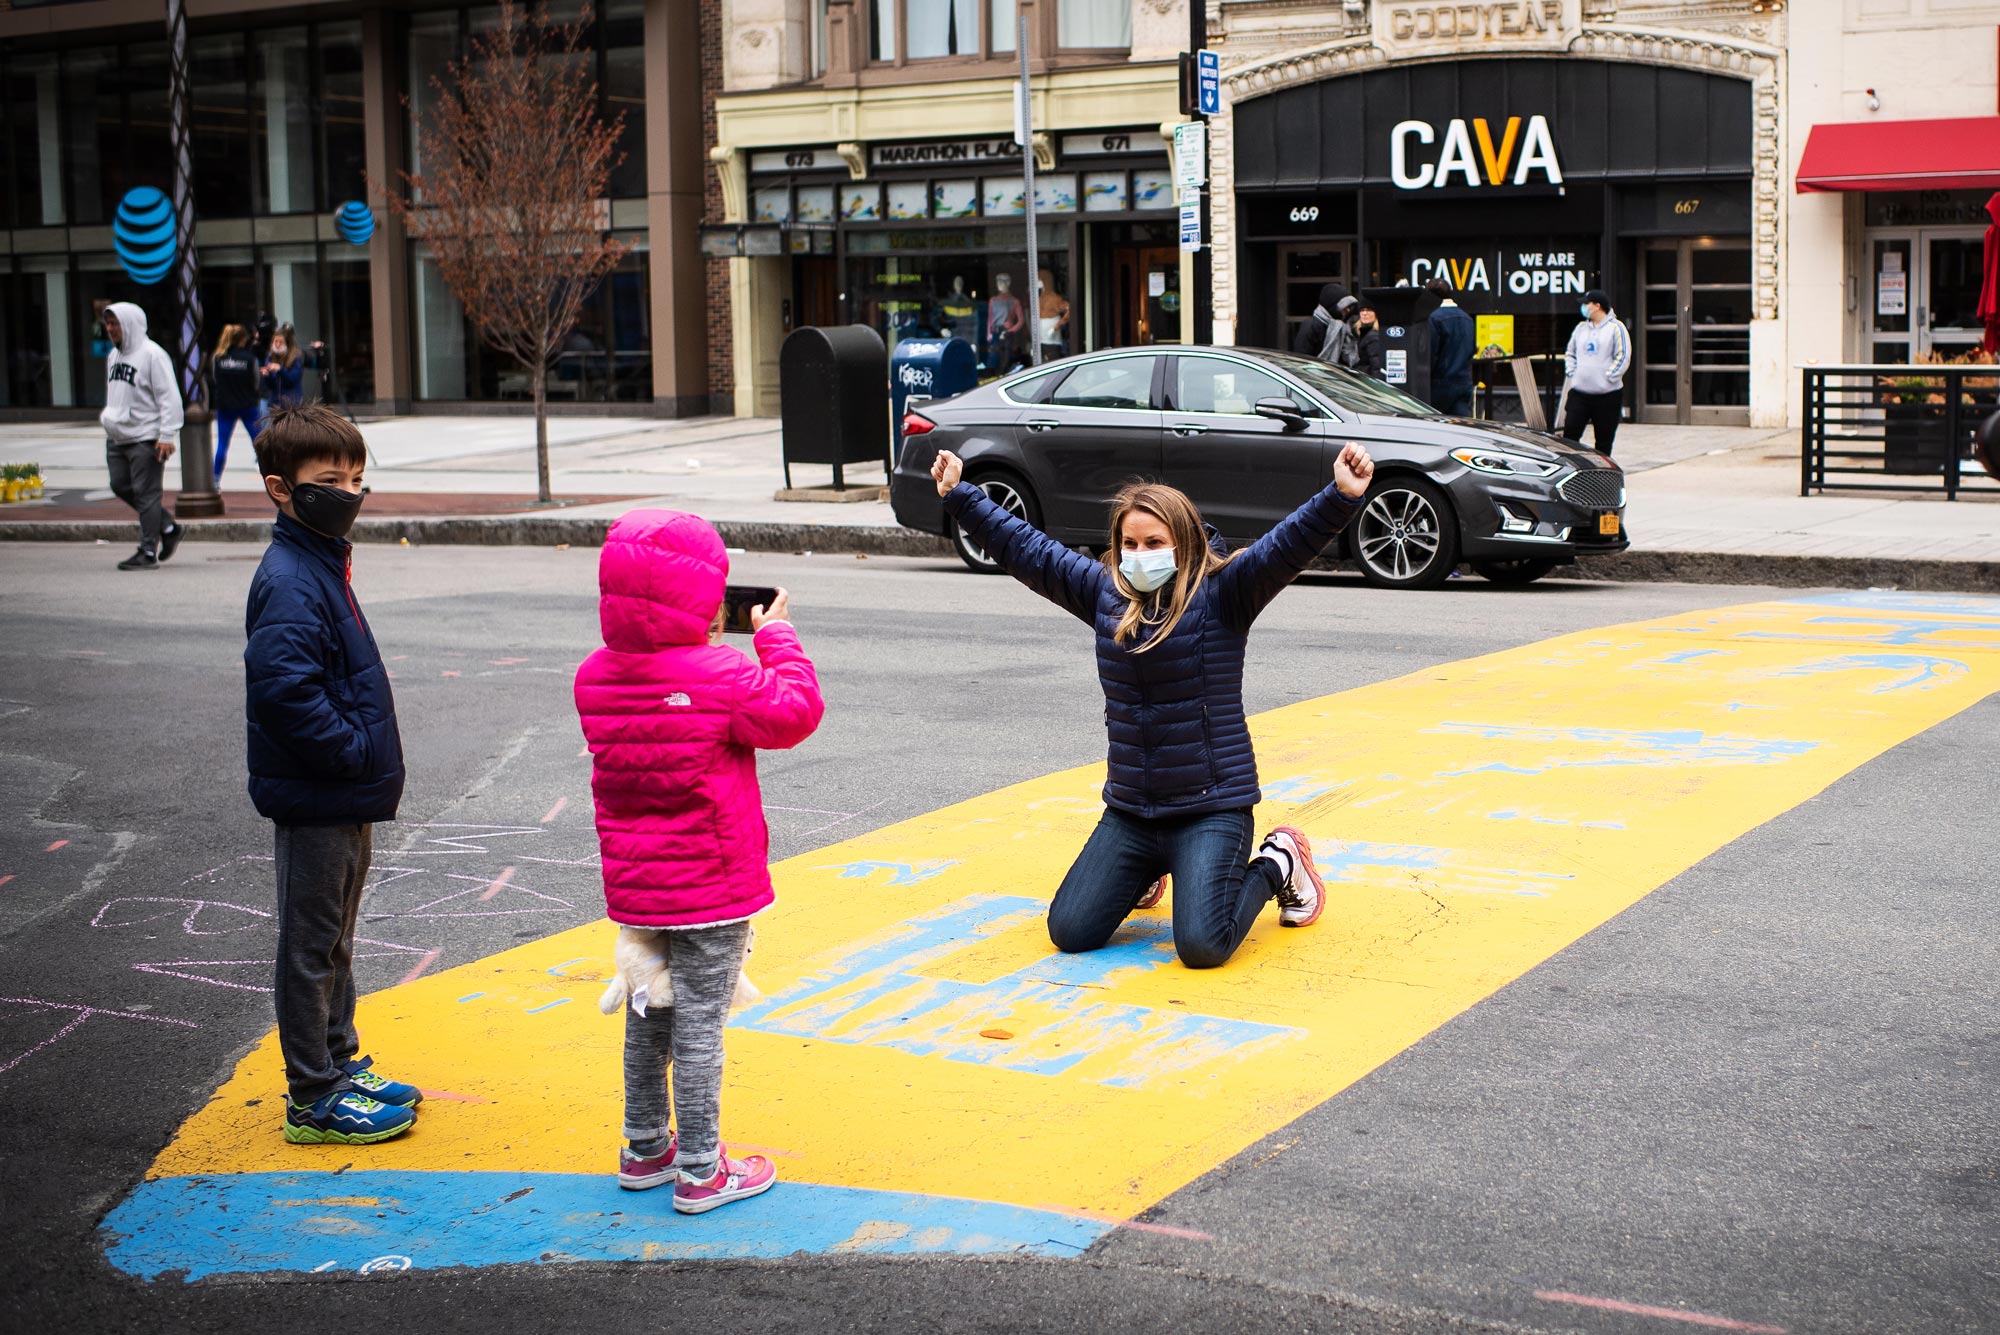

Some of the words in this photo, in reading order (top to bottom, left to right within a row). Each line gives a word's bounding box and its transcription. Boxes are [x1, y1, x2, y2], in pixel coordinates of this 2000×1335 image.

[1392, 1, 1564, 39] GOODYEAR
[1102, 135, 1130, 150] 671
[784, 151, 815, 168] 673
[879, 143, 967, 162] MARATHON
[1391, 115, 1563, 190] CAVA
[1290, 206, 1319, 221] 669
[1674, 199, 1700, 215] 667
[1519, 253, 1542, 267] WE
[1546, 252, 1575, 266] ARE
[1411, 257, 1490, 292] CAVA
[1508, 269, 1586, 294] OPEN
